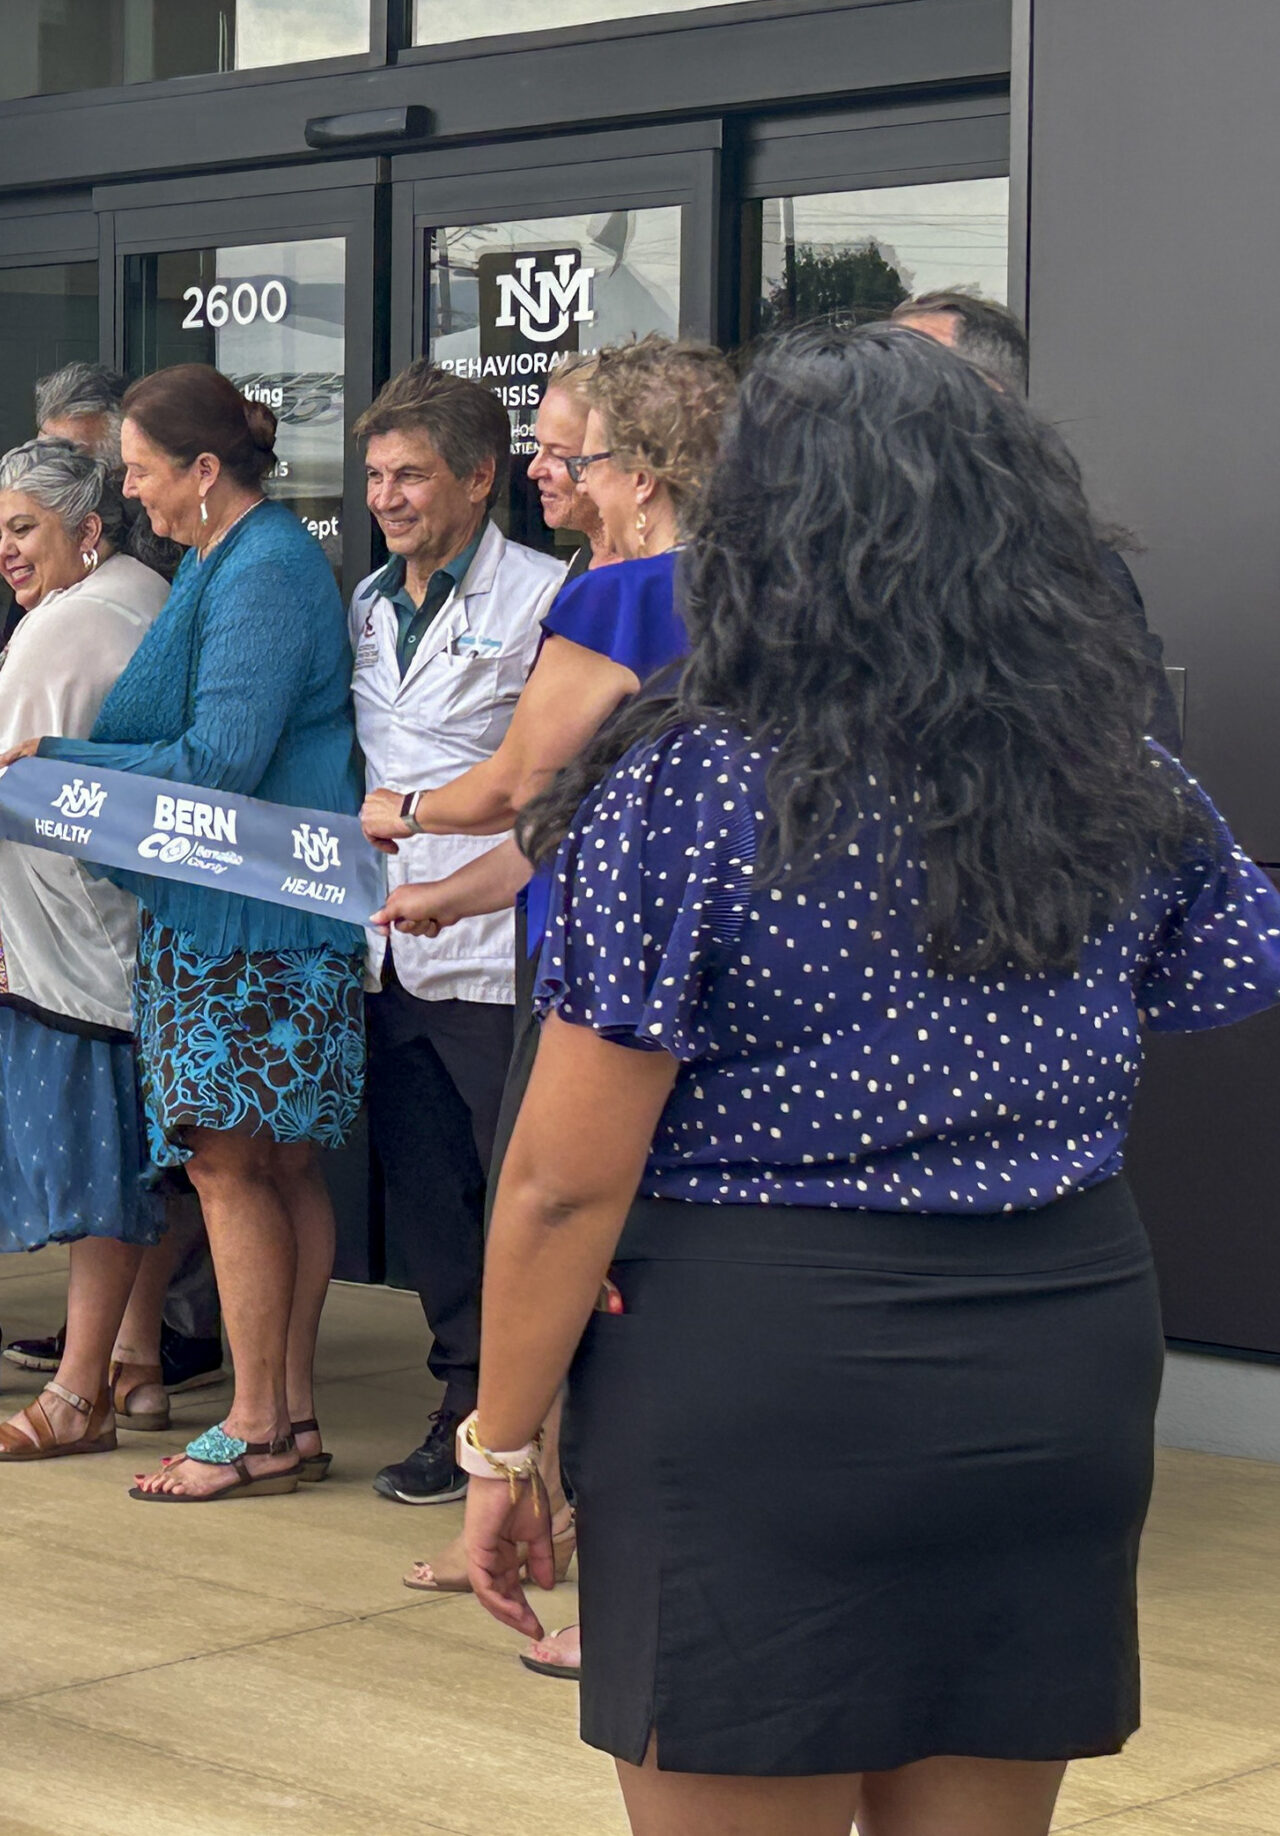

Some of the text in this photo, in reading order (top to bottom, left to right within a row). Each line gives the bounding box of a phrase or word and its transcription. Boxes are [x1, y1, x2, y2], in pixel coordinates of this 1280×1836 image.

[181, 279, 288, 329] 2600
[244, 383, 283, 408] king
[494, 384, 540, 407] ISIS
[301, 516, 339, 540] ept
[34, 818, 92, 845] HEALTH
[153, 794, 238, 844] BERN
[137, 832, 192, 863] CO
[280, 876, 346, 905] HEALTH
